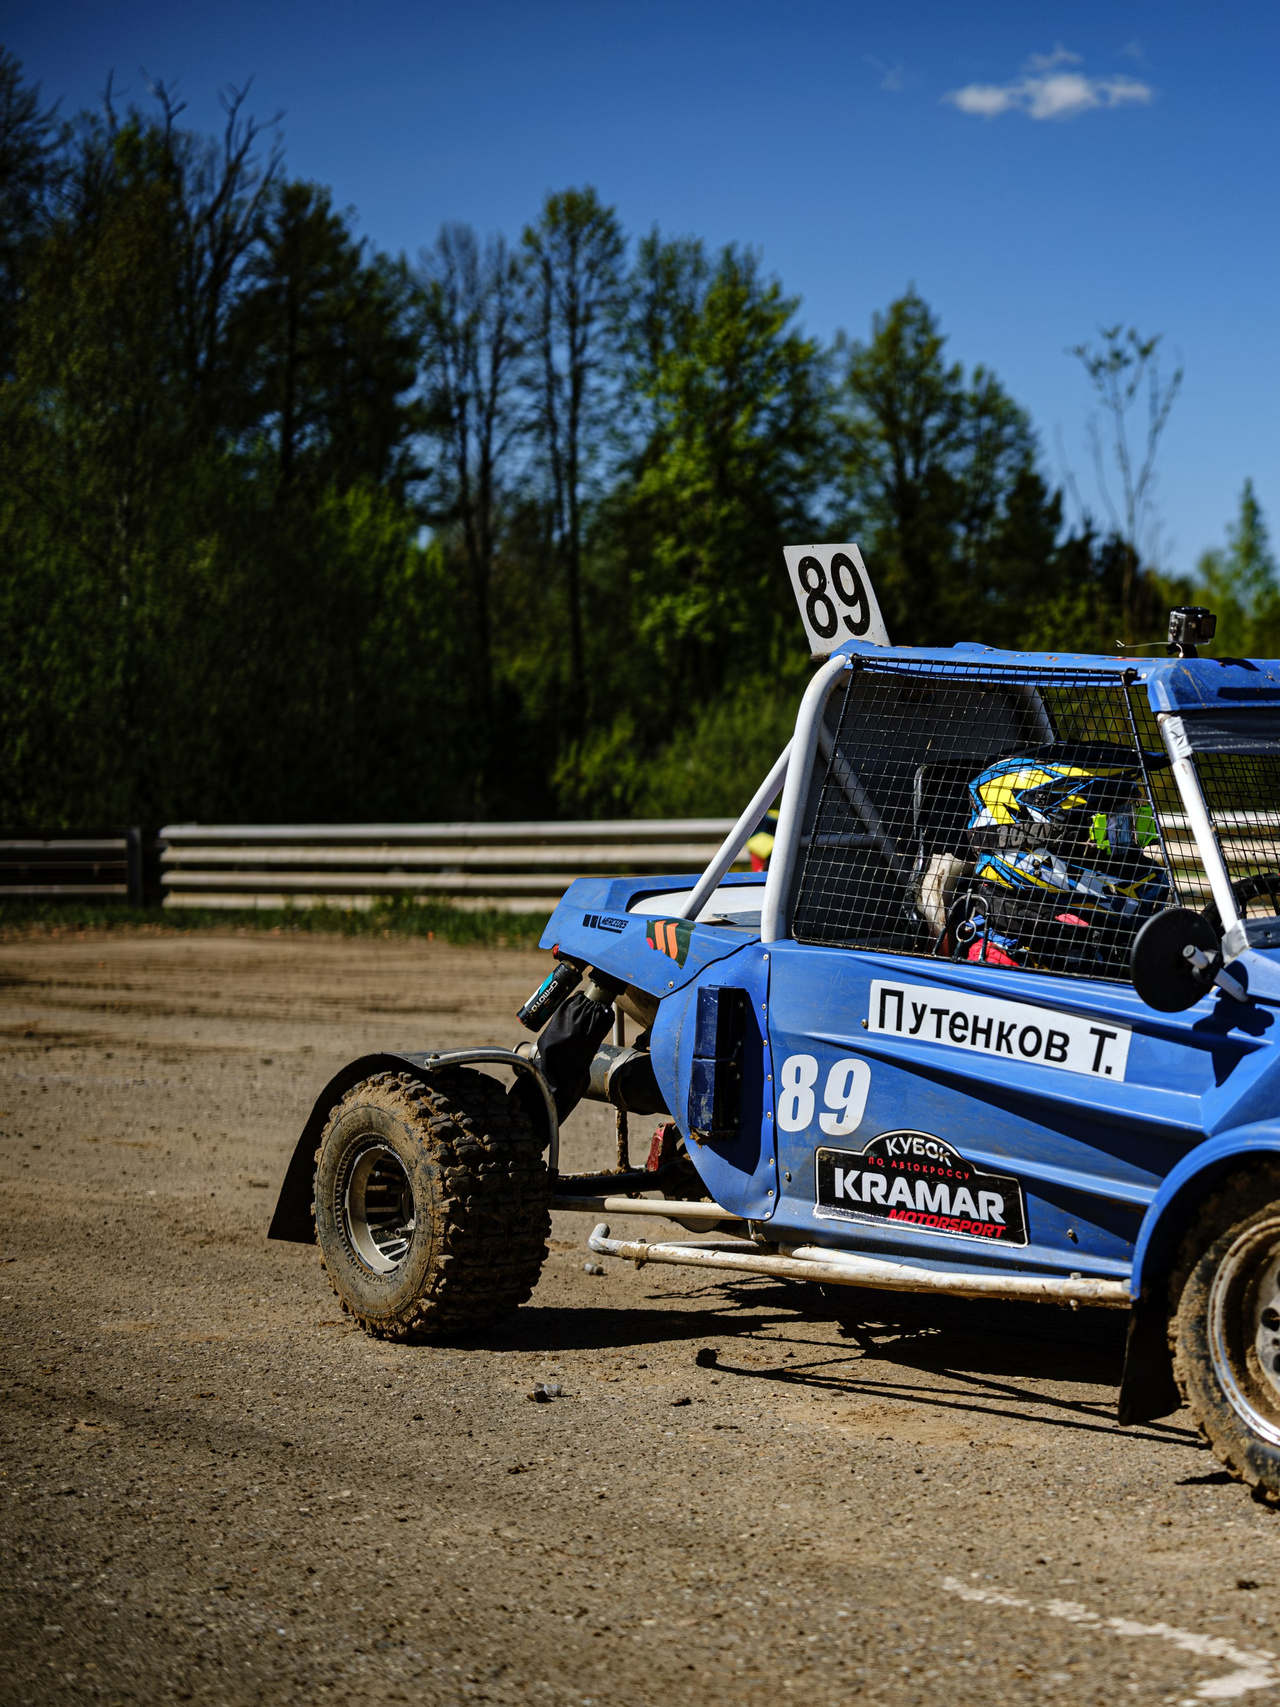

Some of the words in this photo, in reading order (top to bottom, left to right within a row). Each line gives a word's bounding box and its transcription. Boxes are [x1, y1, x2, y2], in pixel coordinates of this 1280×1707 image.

[798, 552, 870, 639] 89
[878, 988, 1070, 1063] Путенков
[1089, 1027, 1118, 1075] Т.
[777, 1054, 871, 1136] 89
[885, 1137, 952, 1167] КУБОК
[891, 1160, 970, 1180] АВТОКРОССУ
[834, 1168, 1006, 1224] KRAMAR
[887, 1209, 1007, 1238] MOTORSPORT
